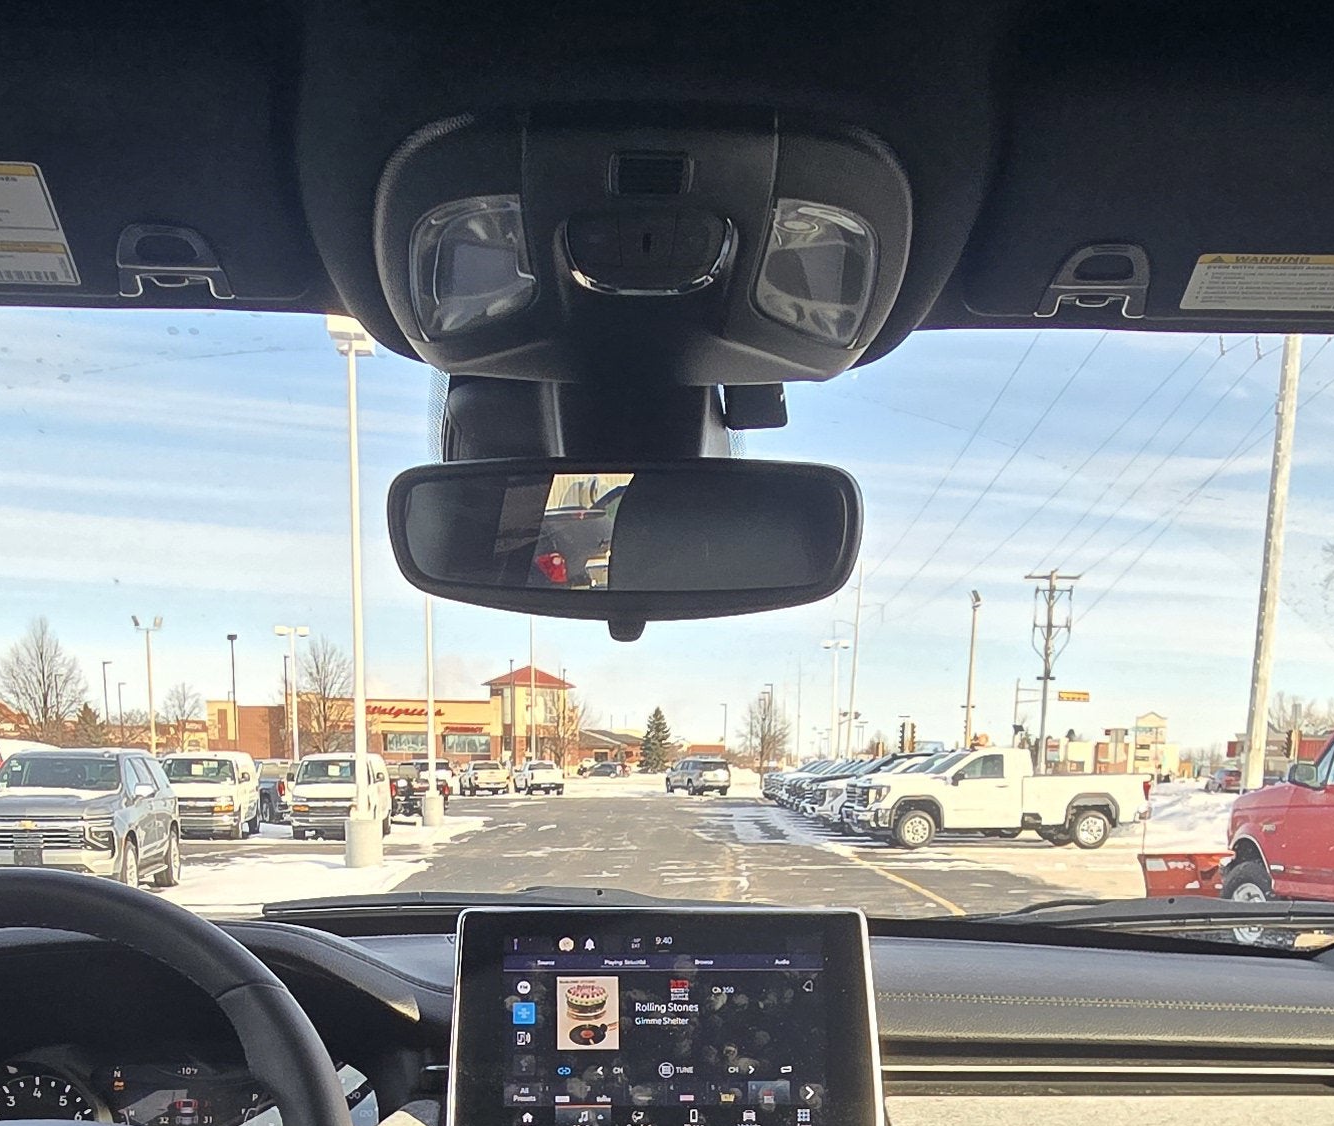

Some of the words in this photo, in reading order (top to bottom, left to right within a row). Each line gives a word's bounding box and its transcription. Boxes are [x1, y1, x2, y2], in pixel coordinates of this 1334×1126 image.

[1235, 255, 1310, 264] WARNING
[635, 1002, 667, 1014] Rolling
[668, 1002, 699, 1012] Stones
[635, 1017, 662, 1025] Gimme
[663, 1016, 689, 1025] Shelter
[33, 1088, 42, 1098] 4
[7, 1096, 16, 1107] 3
[58, 1095, 68, 1106] 5
[74, 1111, 82, 1120] 6
[203, 1116, 213, 1124] 31
